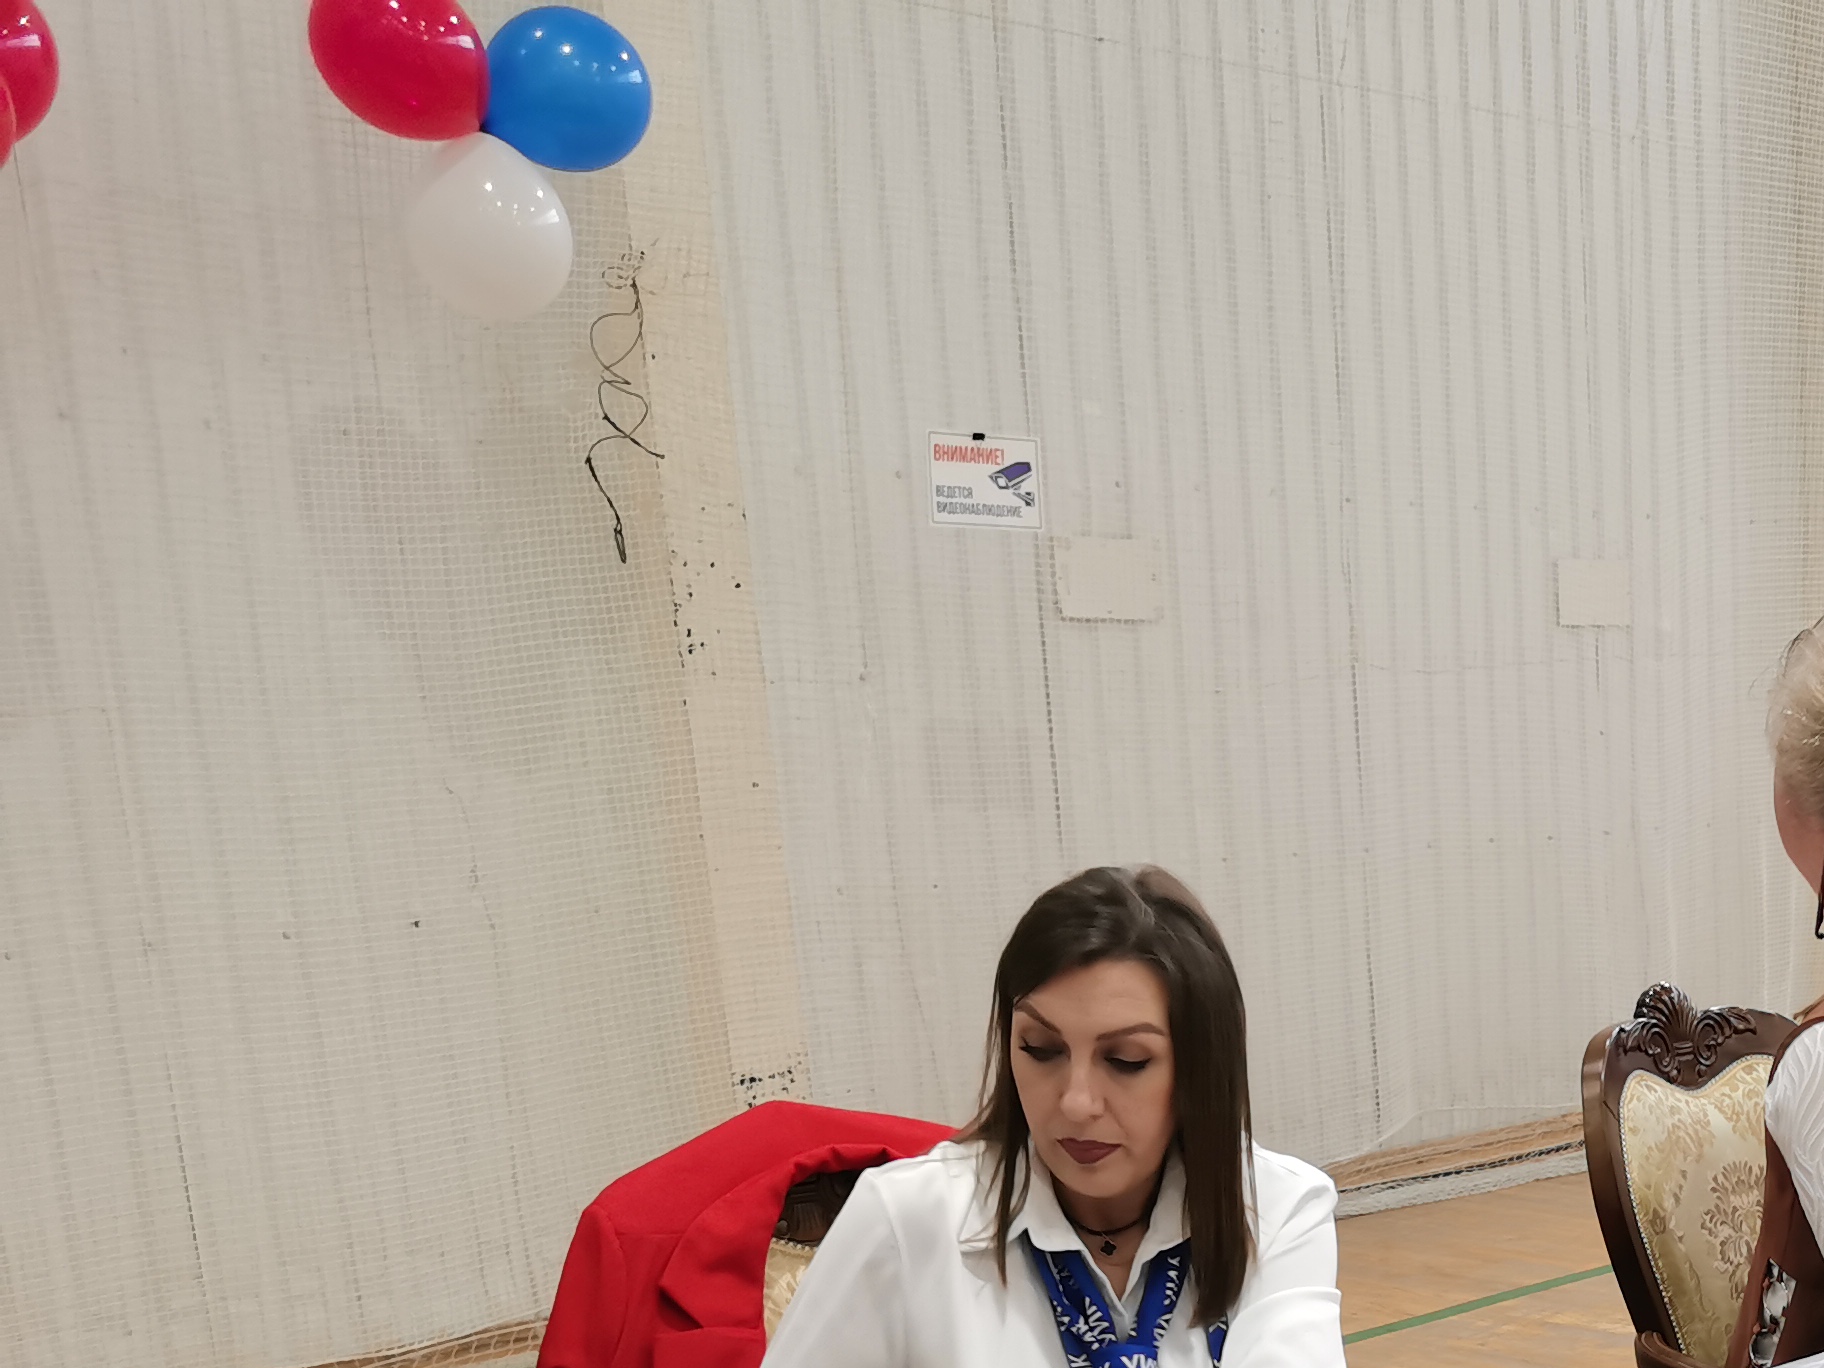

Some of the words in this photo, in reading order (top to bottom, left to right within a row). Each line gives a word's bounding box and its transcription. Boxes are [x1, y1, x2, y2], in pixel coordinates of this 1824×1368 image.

[933, 443, 1005, 466] ВНИМАНИЕ!
[935, 484, 974, 499] ВЕДЕТСЯ
[936, 500, 1024, 518] ВИДЕОНАБЛЮДЕНИЕ
